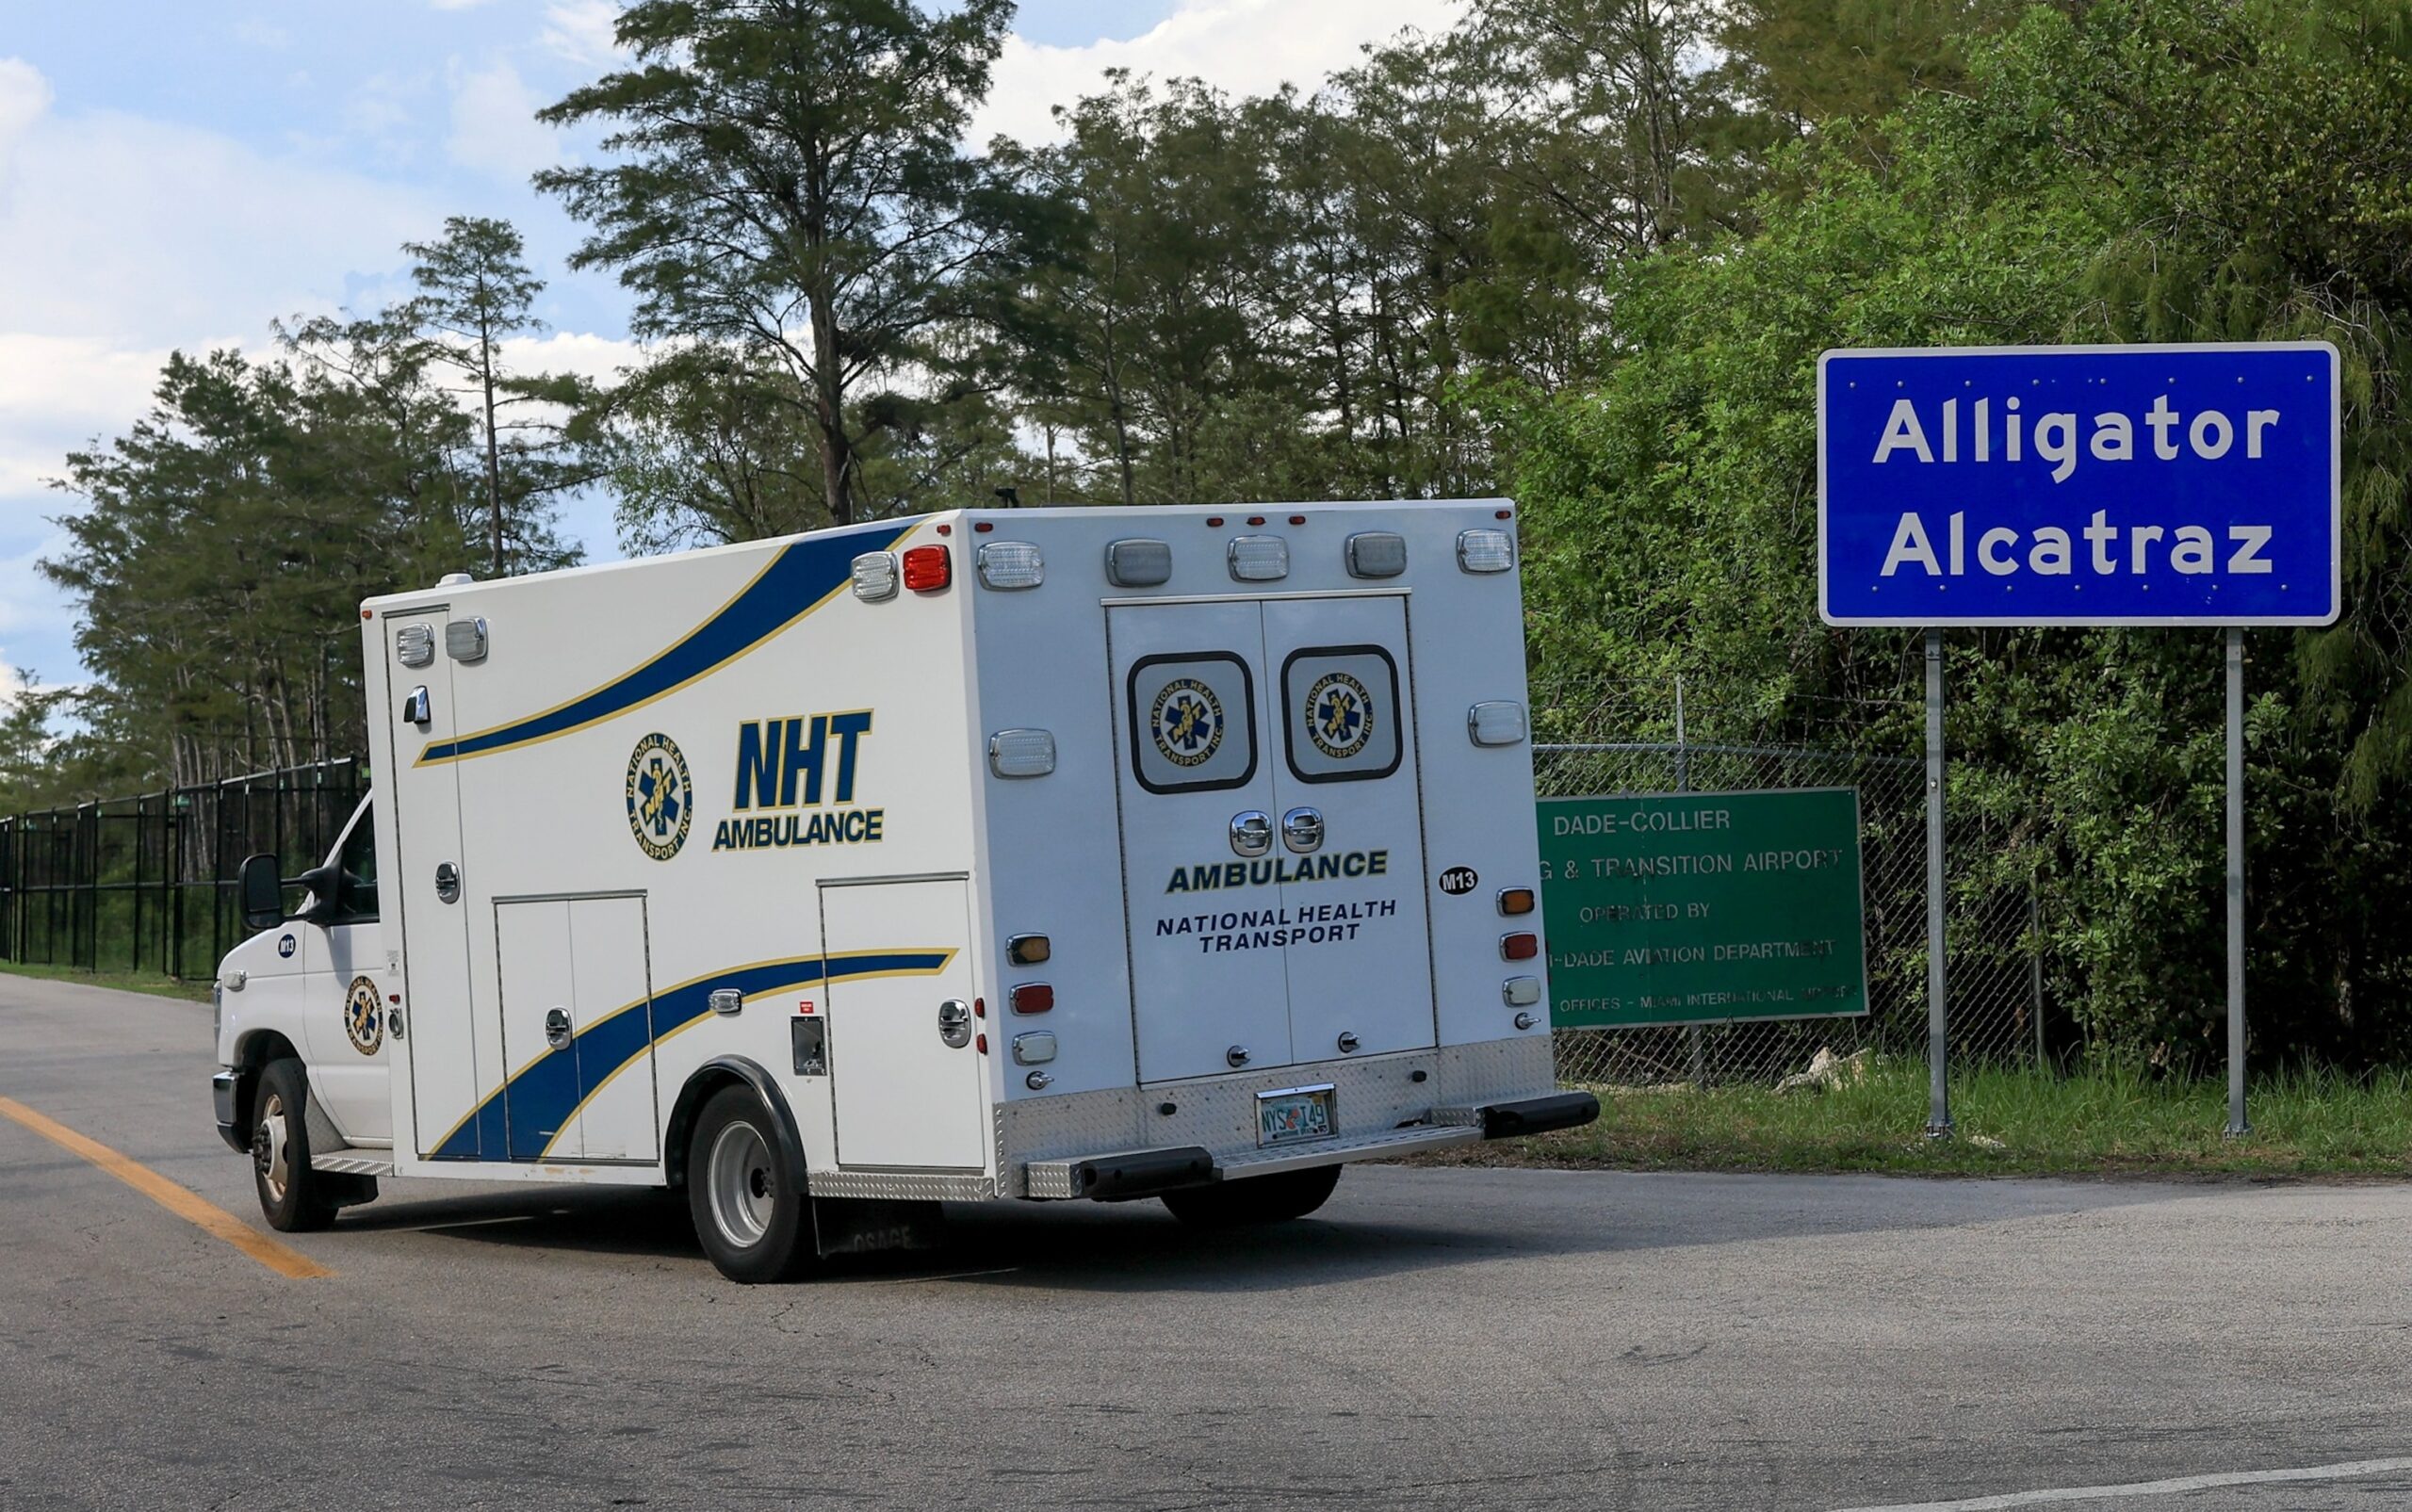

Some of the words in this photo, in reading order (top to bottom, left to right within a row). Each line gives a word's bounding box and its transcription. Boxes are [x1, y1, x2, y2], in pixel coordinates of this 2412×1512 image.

[1871, 394, 2280, 484] Alligator
[1880, 509, 2273, 576] Alcatraz
[1152, 680, 1187, 727] NATIONAL
[1191, 681, 1221, 716] HEALTH
[1307, 675, 1334, 726] NATIONAL
[1336, 674, 1369, 704] HEALTH
[732, 708, 874, 813] NHT
[1155, 734, 1212, 765] TRANSPORT
[1312, 733, 1366, 757] TRANSPORT
[627, 735, 659, 797] NATIONAL
[662, 737, 691, 792] HEALTH
[629, 809, 679, 859] TRANSPORT
[711, 807, 885, 853] AMBULANCE
[1554, 809, 1731, 837] DADE-COLLIER
[1165, 849, 1389, 895] AMBULANCE
[1442, 870, 1475, 892] M13
[1565, 860, 1579, 880] &
[1590, 854, 1733, 879] TRANSITION
[1743, 849, 1843, 872] AIRPORT
[1156, 908, 1291, 937] NATIONAL
[1297, 899, 1396, 925] HEALTH
[1579, 902, 1679, 923] OPERATED
[1687, 902, 1710, 919] BY
[1199, 923, 1360, 953] TRANSPORT
[1622, 945, 1704, 967] AVIATION
[1714, 939, 1836, 962] DEPARTMENT
[1559, 997, 1621, 1013] OFFICES
